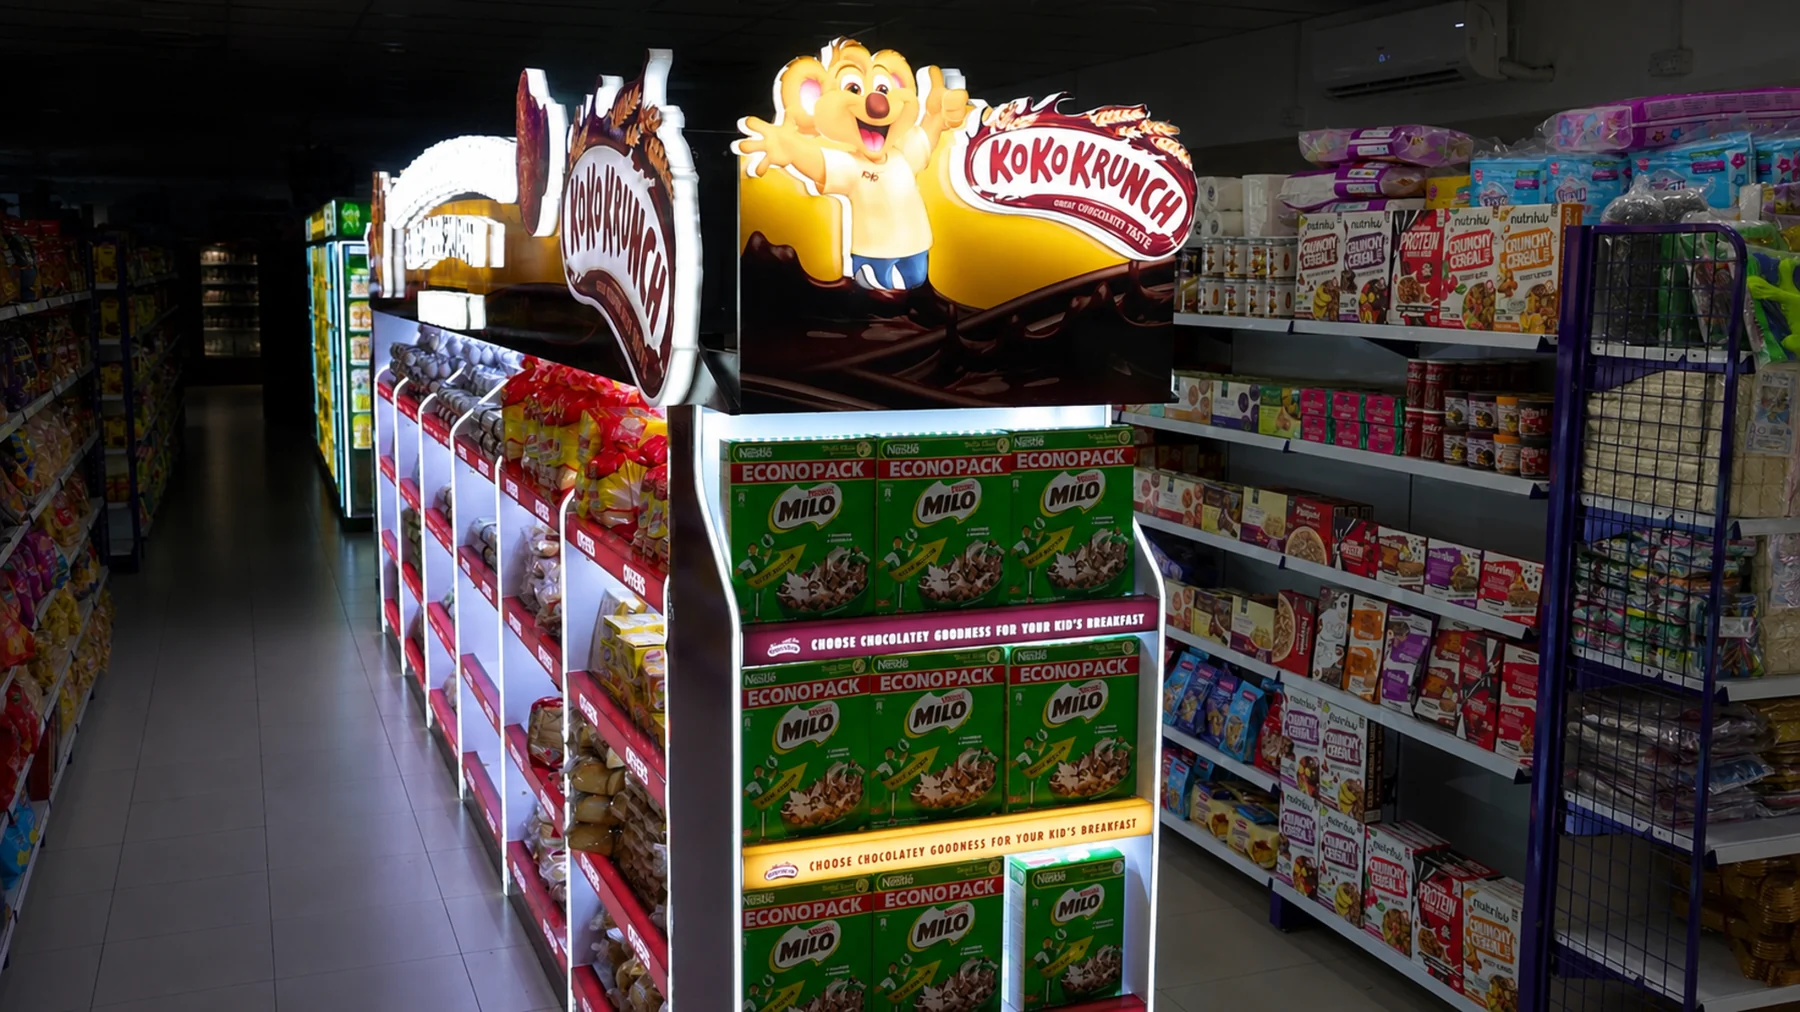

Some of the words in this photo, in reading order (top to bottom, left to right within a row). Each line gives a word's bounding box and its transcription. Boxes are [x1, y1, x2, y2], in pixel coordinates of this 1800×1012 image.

[1126, 223, 1152, 250] TASTE
[922, 491, 976, 517] MILO
[1049, 481, 1099, 506] MILO
[778, 496, 835, 522] MILO
[623, 564, 646, 596] OFFERS
[811, 636, 856, 651] CHOOSE
[860, 631, 929, 647] CHOCOLATEY
[934, 626, 991, 641] GOODNESS
[996, 623, 1017, 637] FOR
[1022, 621, 1050, 635] YOUR
[1054, 619, 1082, 632] KID'S
[1087, 614, 1144, 629] BREAKFAST
[914, 701, 966, 728] MILO
[1052, 692, 1102, 718] MILO
[781, 713, 833, 743] MILO
[809, 856, 852, 871] CHOOSE
[857, 846, 925, 865] CHOCOLATEY
[930, 838, 985, 856] GOODNESS
[991, 835, 1011, 848] FOR
[1016, 831, 1044, 844] YOUR
[1049, 827, 1076, 839] KID'S
[1081, 818, 1137, 835] BREAKFAST
[1058, 894, 1100, 917] MILO
[916, 913, 969, 942] MILO
[779, 933, 834, 963] MILO
